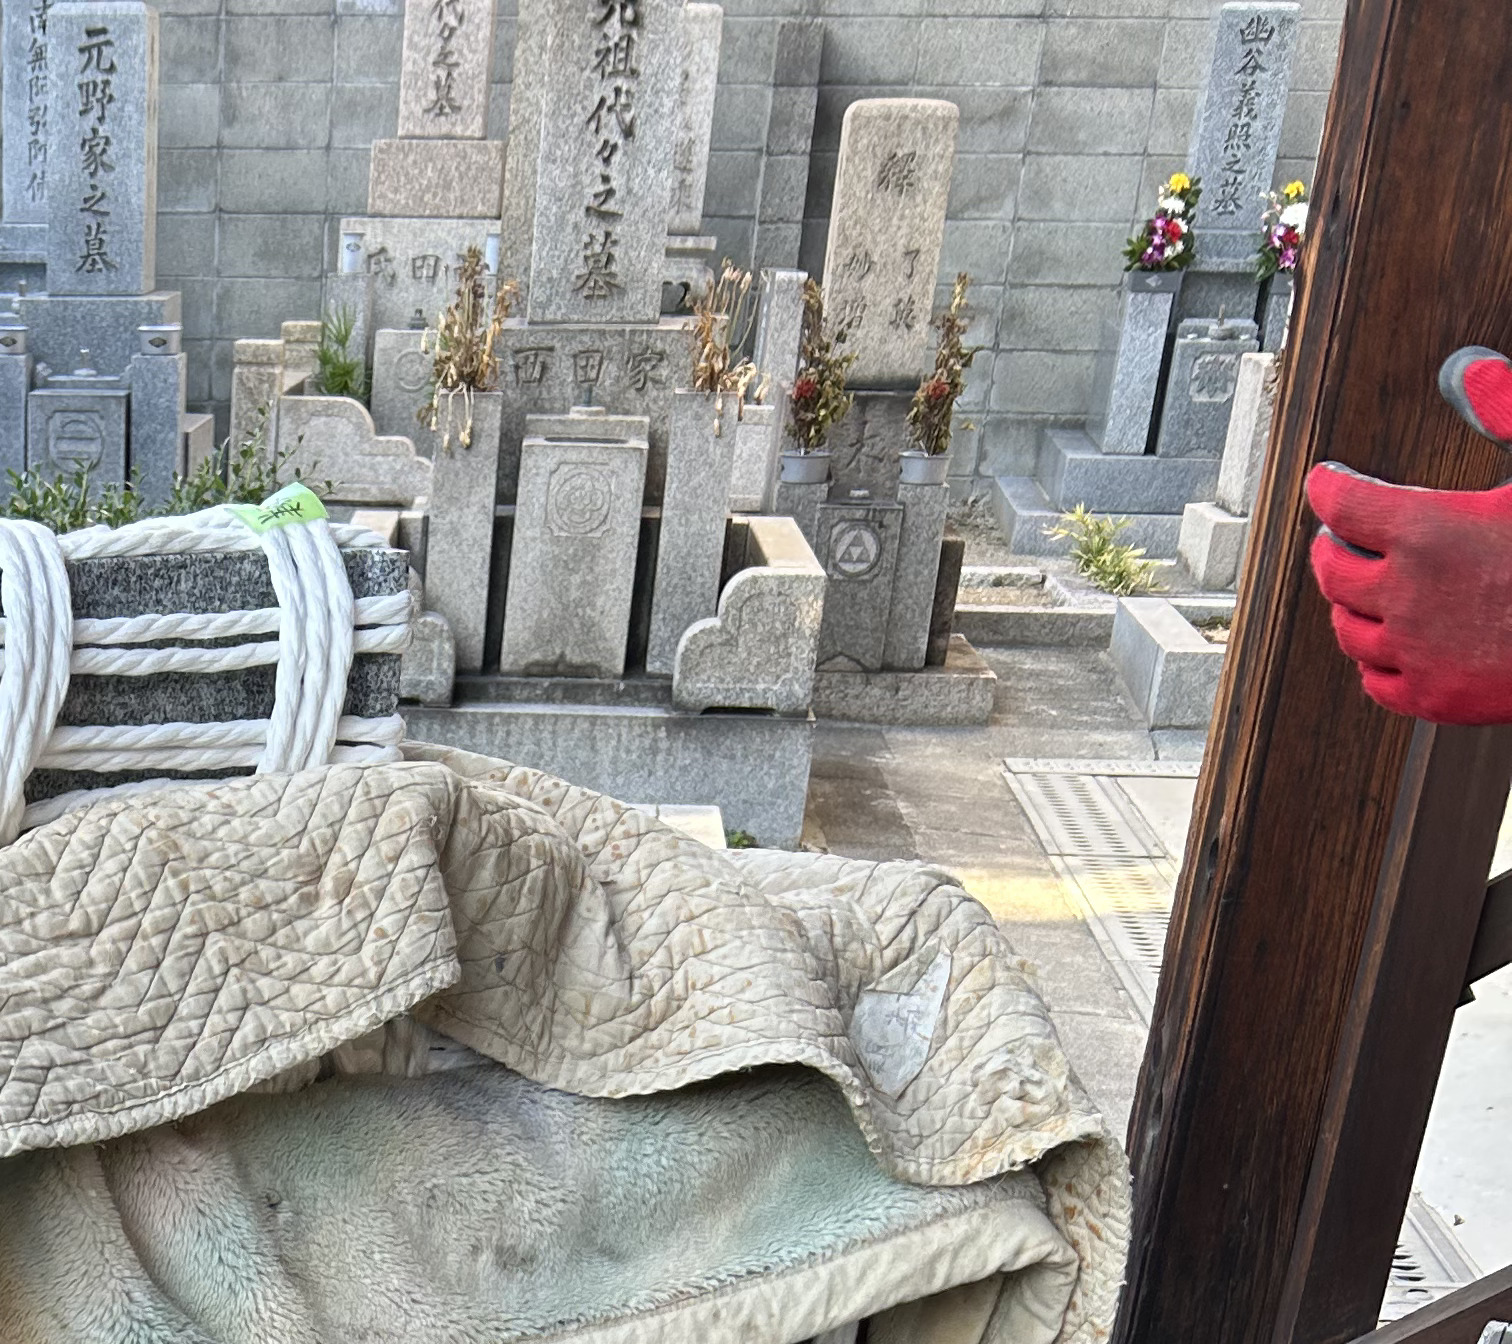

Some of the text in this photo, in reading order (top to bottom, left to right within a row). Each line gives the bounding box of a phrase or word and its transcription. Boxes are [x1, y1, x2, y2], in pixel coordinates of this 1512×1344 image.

[75, 26, 117, 274] 元野家之墓
[513, 345, 666, 391] 西田家
